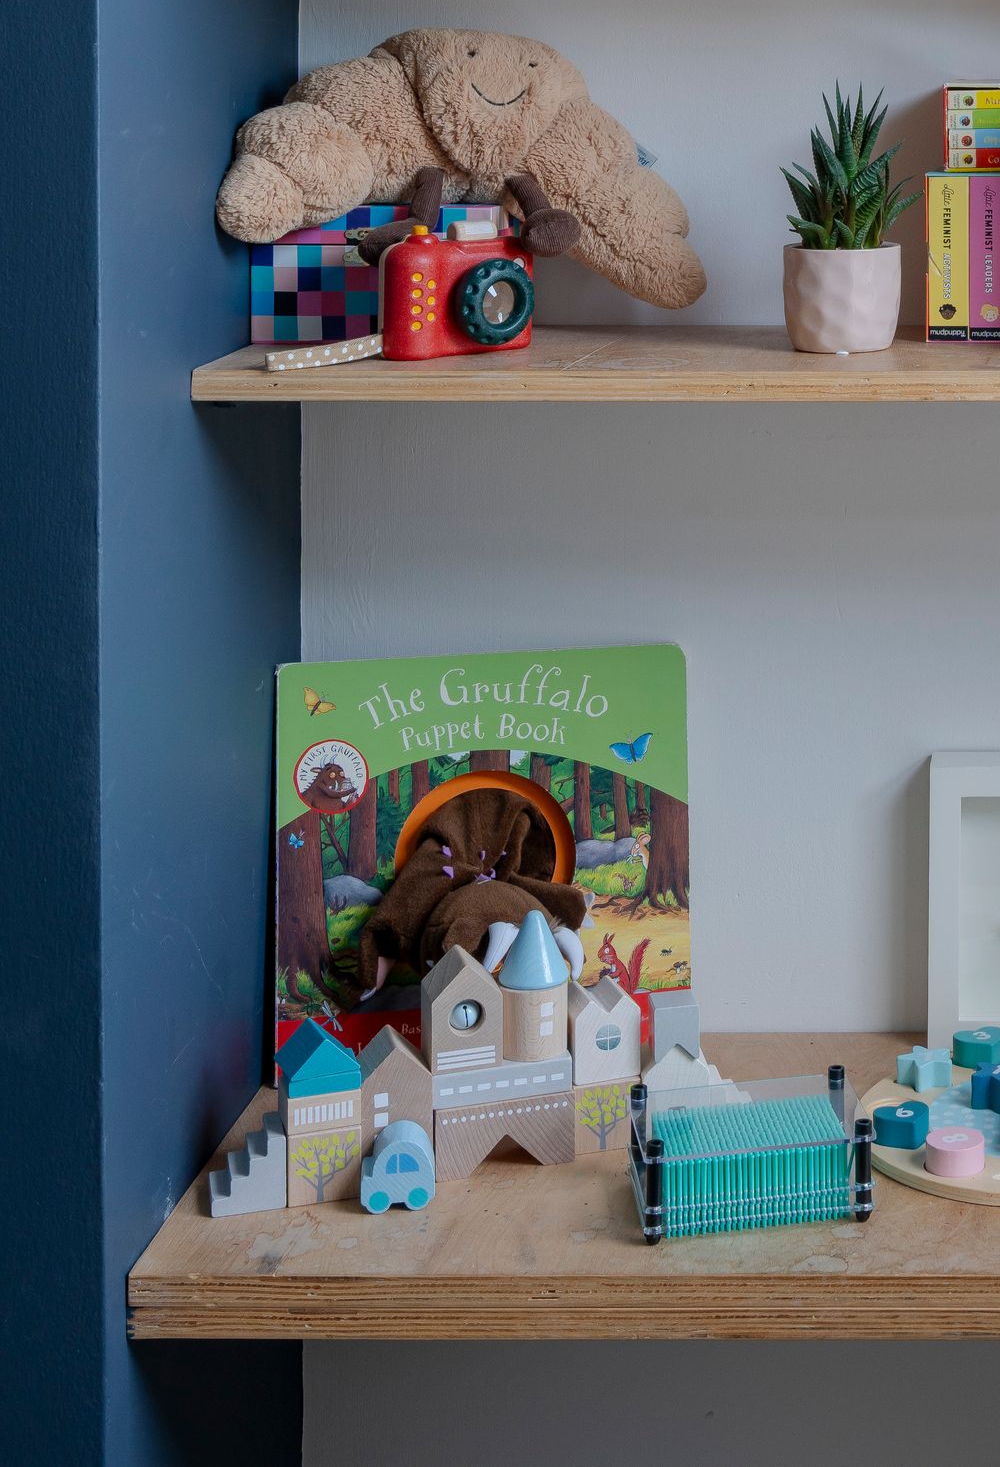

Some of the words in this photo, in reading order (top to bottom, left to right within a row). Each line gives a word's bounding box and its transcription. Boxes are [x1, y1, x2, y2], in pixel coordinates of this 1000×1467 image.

[943, 208, 952, 249] FEMINIST
[984, 210, 992, 250] FEMINIST
[943, 253, 952, 299] ACTIVISTS
[984, 254, 992, 294] LEADERS
[358, 683, 425, 729] The
[440, 664, 609, 718] Gruffalo
[398, 714, 485, 752] Puppet
[496, 713, 568, 744] Book
[300, 769, 308, 781] MY
[304, 746, 326, 766] FIRST
[330, 744, 364, 778] GRUFFALO
[972, 1032, 991, 1040] 3
[896, 1108, 914, 1118] 6
